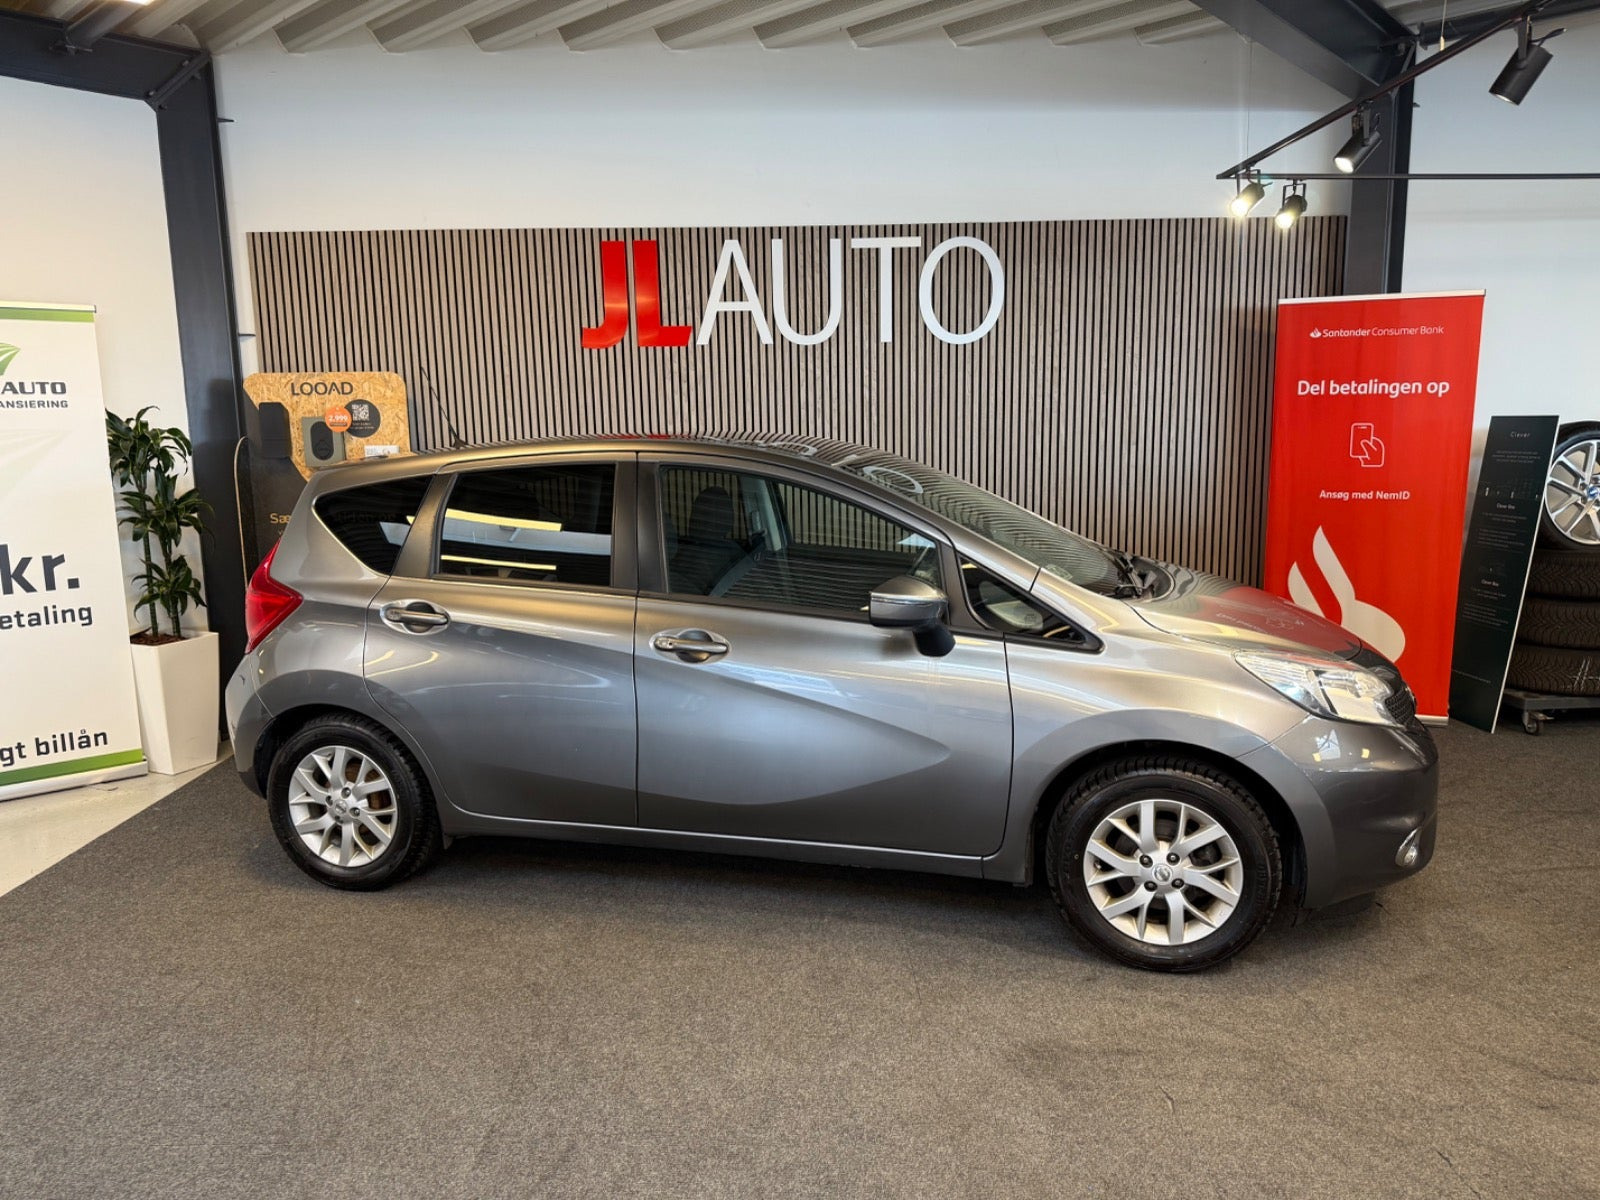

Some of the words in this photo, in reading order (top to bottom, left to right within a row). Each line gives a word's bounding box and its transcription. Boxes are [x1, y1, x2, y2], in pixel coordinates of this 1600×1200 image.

[582, 240, 692, 349] JL
[696, 236, 1005, 345] AUTO
[1322, 328, 1370, 338] Santander
[1372, 326, 1418, 336] Consumer
[1420, 325, 1444, 335] Bank
[1, 381, 67, 394] AUTO
[1298, 380, 1325, 396] Del
[1330, 378, 1422, 398] betalingen
[1426, 381, 1450, 398] op
[1319, 489, 1349, 501] Ansøg
[1352, 490, 1374, 499] med
[1376, 490, 1410, 500] NemID
[0, 544, 80, 595] kr.
[0, 604, 93, 629] etaling
[35, 728, 108, 756] billån
